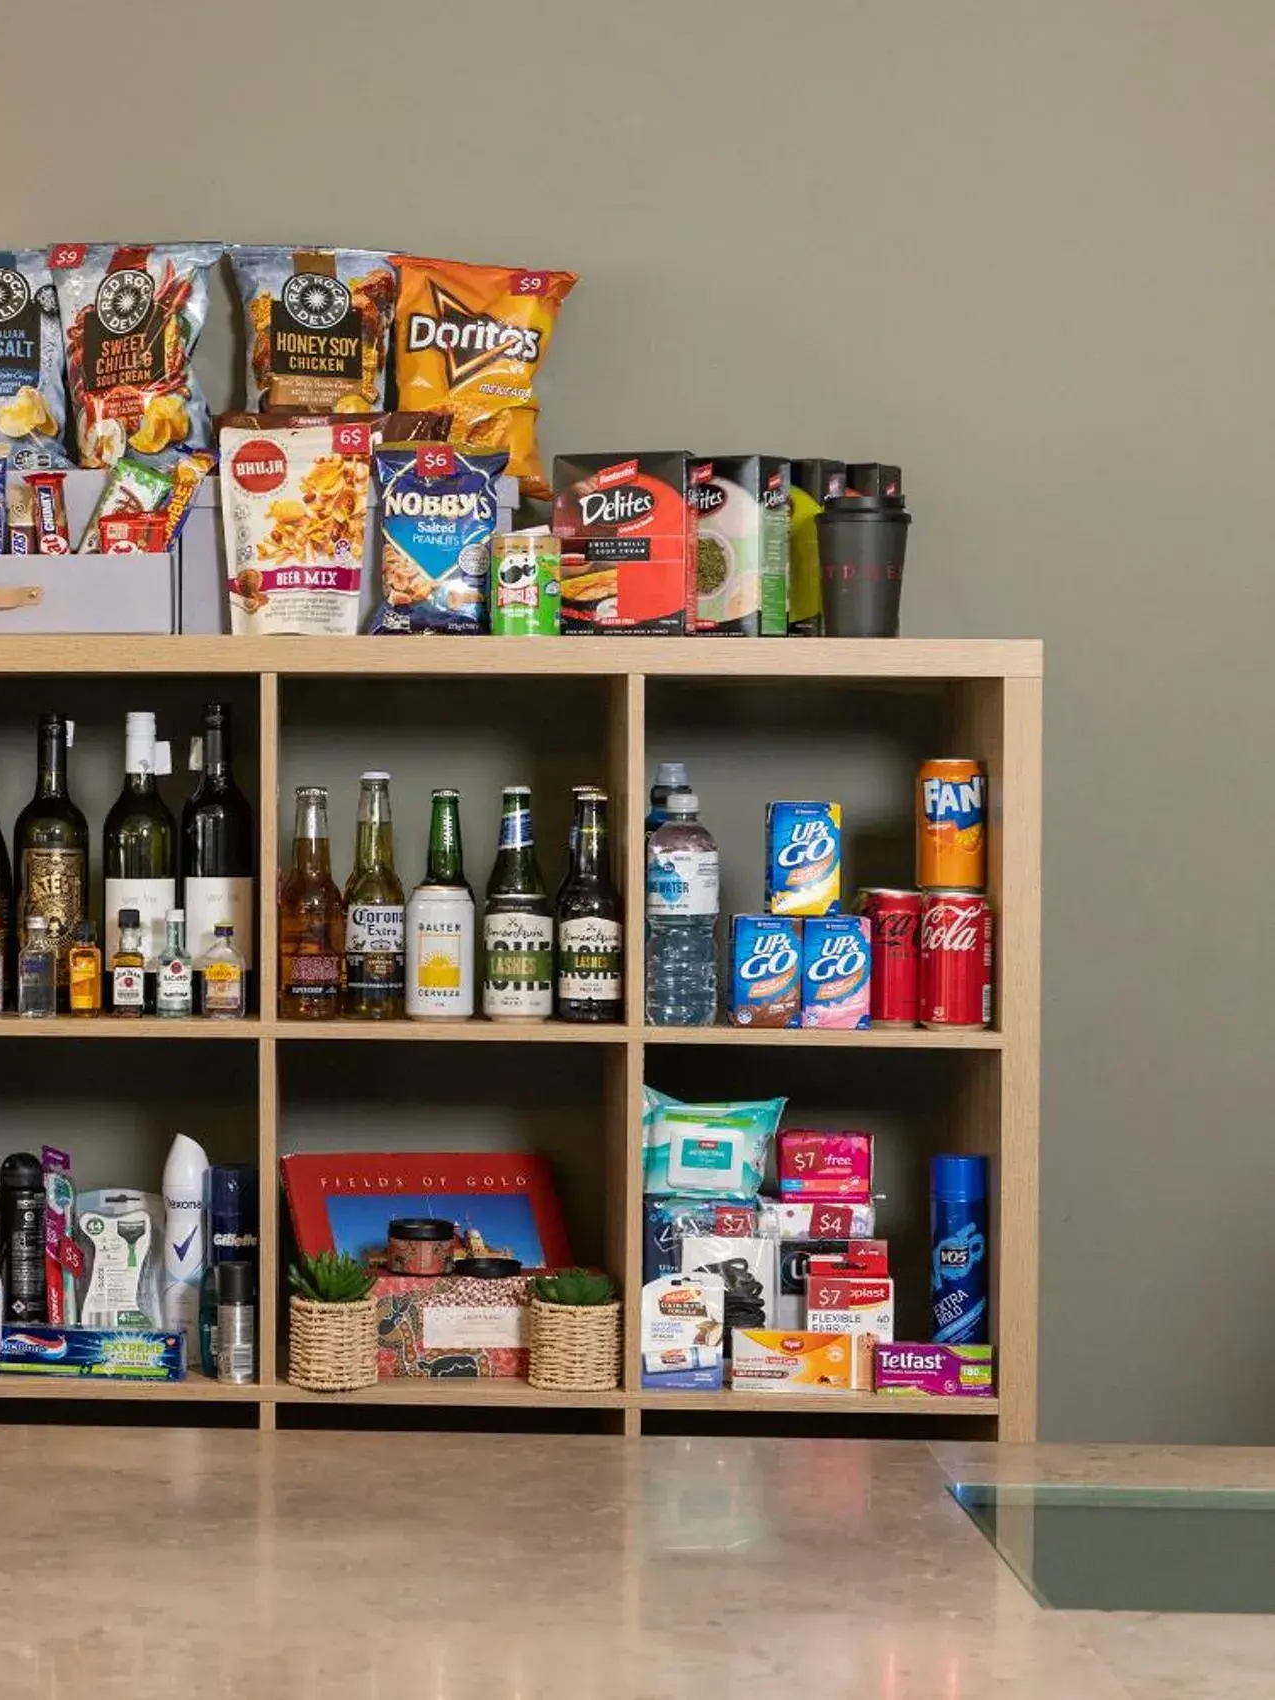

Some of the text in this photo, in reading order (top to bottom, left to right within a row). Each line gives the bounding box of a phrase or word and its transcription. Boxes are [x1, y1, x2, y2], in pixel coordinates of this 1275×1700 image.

[520, 278, 542, 292] $9
[109, 312, 141, 330] DELI
[297, 310, 335, 326] DELI
[101, 333, 146, 357] SWEET
[276, 331, 359, 357] HONEY SOY
[409, 315, 540, 360] Doritos
[289, 356, 345, 372] CHICKEN
[119, 369, 151, 384] CREAM
[424, 453, 447, 470] $6
[385, 490, 492, 520] NOBBY'S
[579, 490, 653, 527] Delites
[417, 522, 457, 534] Salted
[276, 571, 338, 586] BEER MIX
[923, 776, 983, 816] FAN
[778, 836, 836, 867] GO
[366, 924, 398, 937] Extra
[417, 923, 462, 932] BALTER
[490, 956, 537, 975] LASHES
[740, 949, 799, 980] GO
[807, 951, 867, 982] GO
[794, 1152, 815, 1171] $7
[320, 1176, 527, 1189] FIELDS OF GOLD
[819, 1213, 842, 1234] $4
[819, 1287, 841, 1307] $7
[933, 1289, 969, 1317] EXTRA
[811, 1313, 862, 1323] FLEXIBLE
[879, 1351, 943, 1370] Telfast
